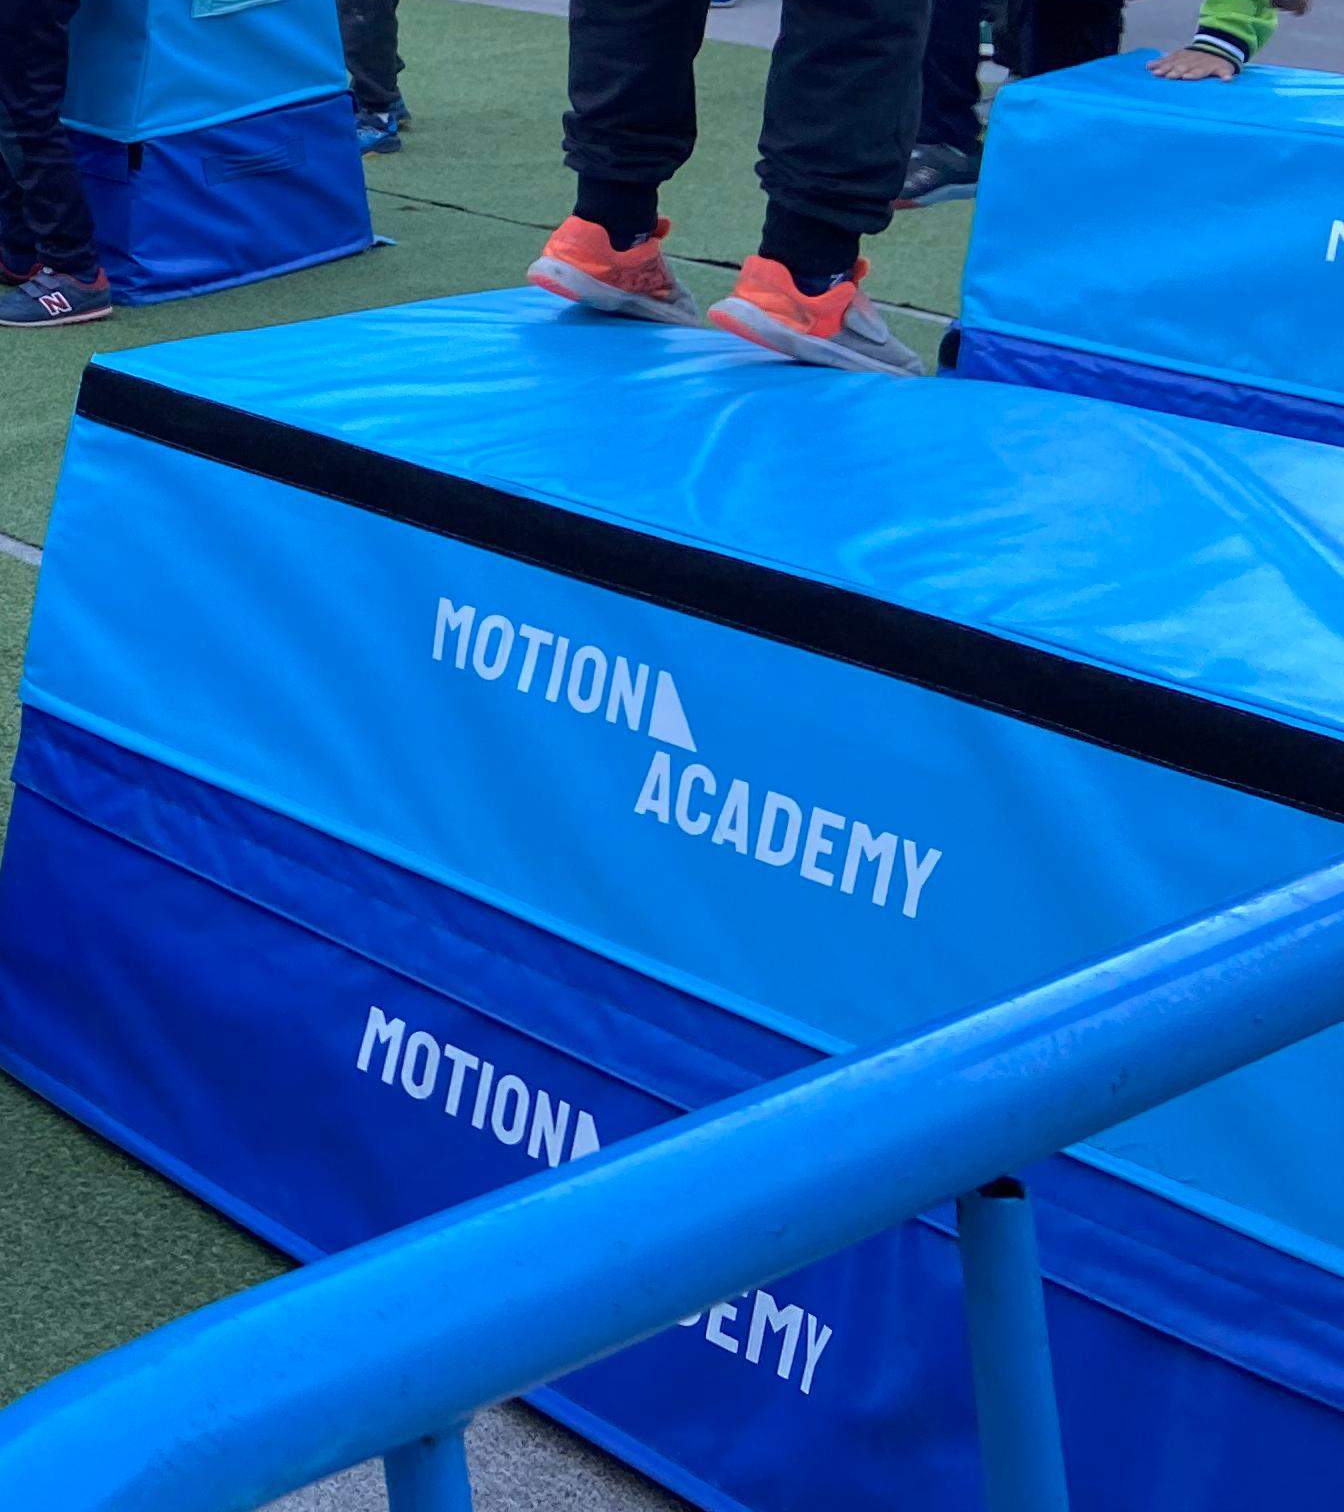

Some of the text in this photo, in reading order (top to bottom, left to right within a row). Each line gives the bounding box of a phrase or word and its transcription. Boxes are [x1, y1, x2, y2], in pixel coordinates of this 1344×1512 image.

[432, 597, 650, 732] MOTION
[634, 751, 943, 919] ACADEMY
[356, 1005, 571, 1168] MOTION
